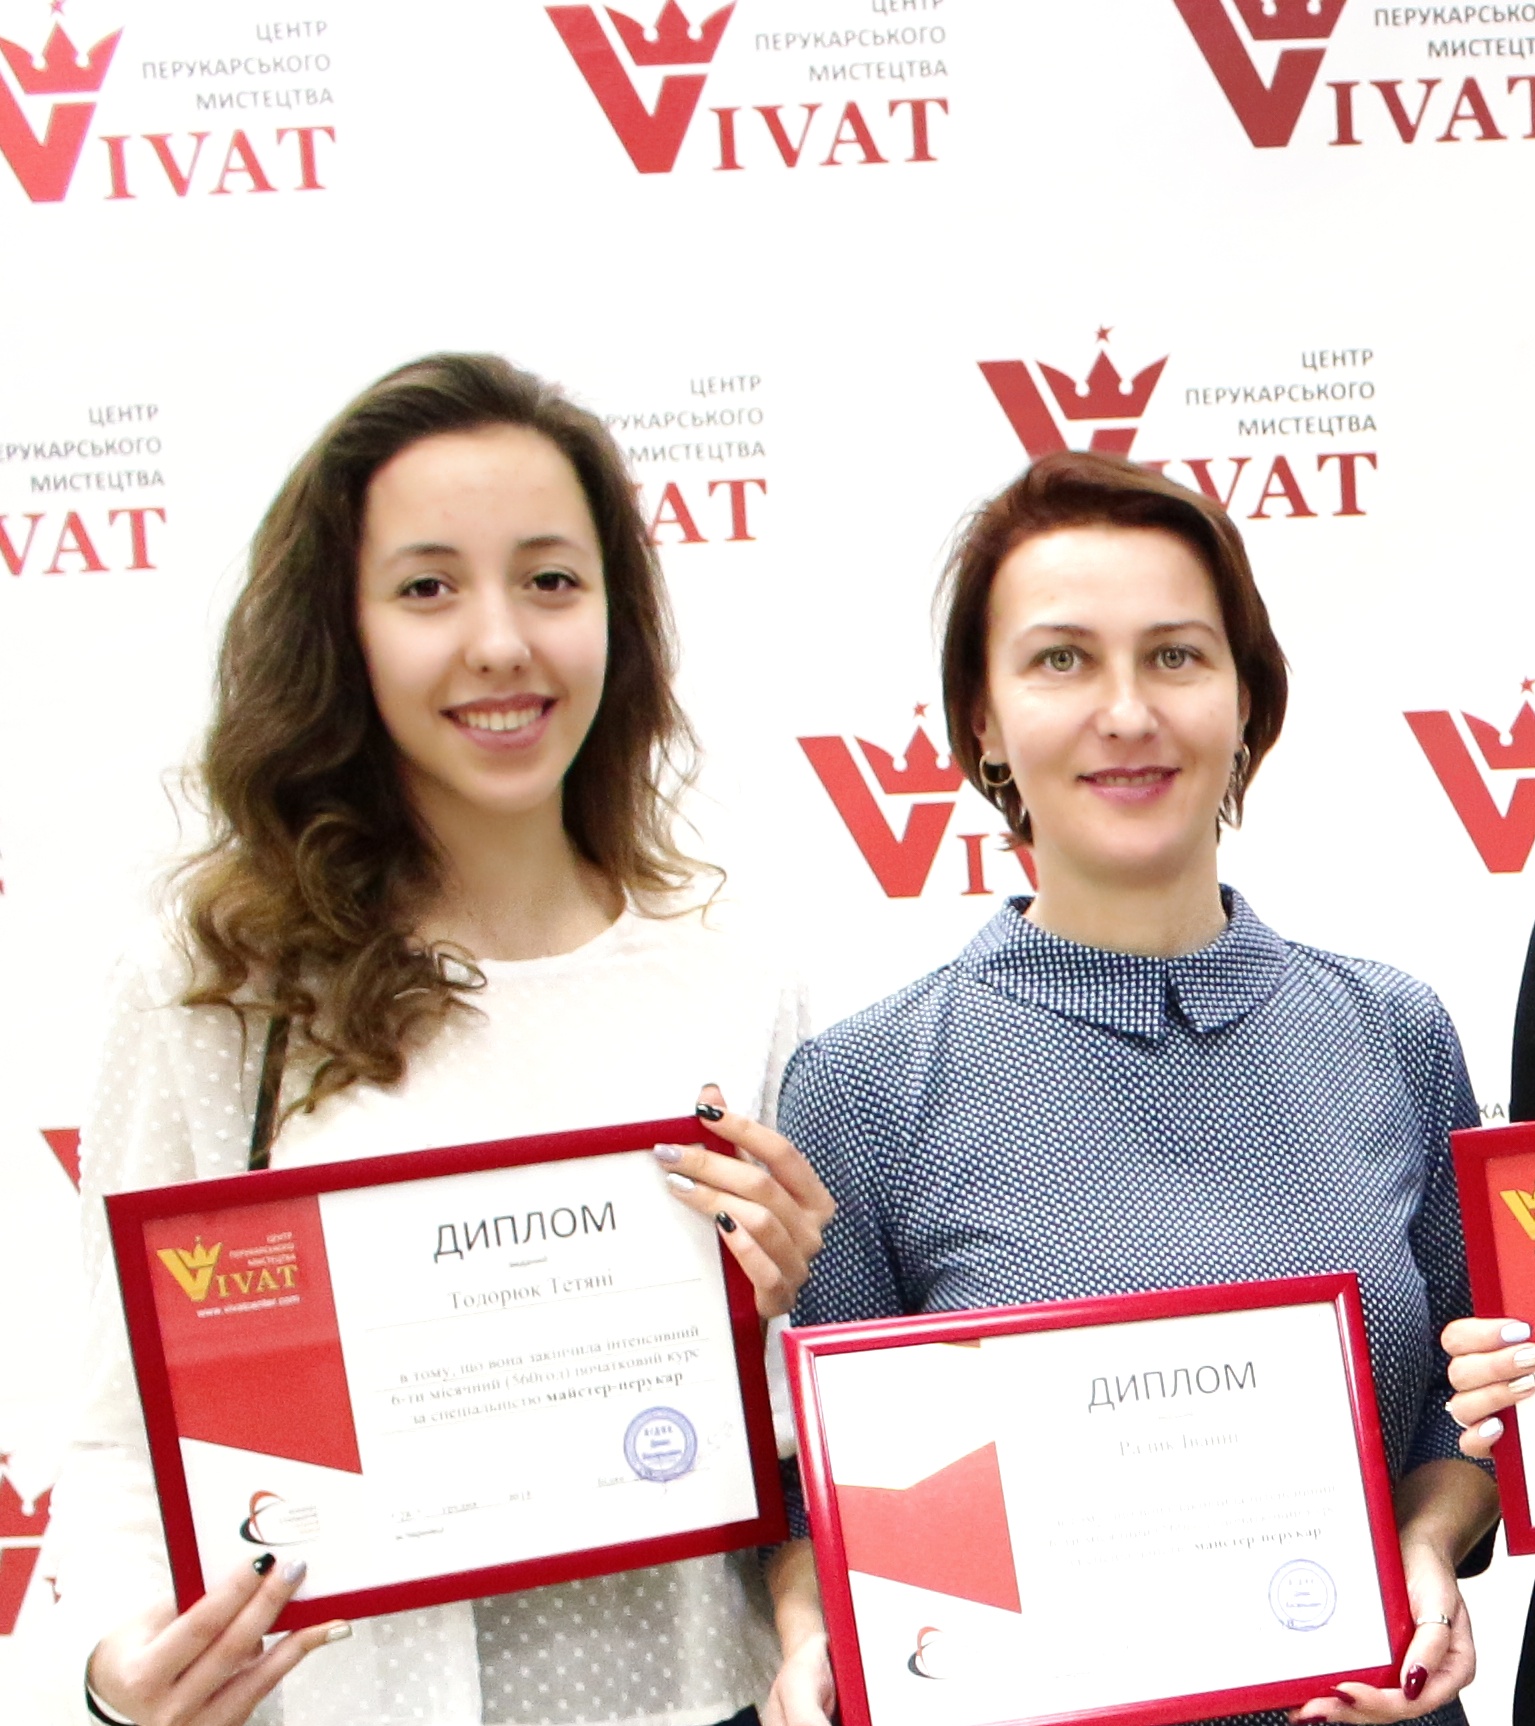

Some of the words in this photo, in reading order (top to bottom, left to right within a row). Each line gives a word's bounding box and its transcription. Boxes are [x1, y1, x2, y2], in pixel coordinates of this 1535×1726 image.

[255, 20, 328, 44] ЦЕНТР
[755, 25, 946, 51] ПЕРУКАРСЬКОГО
[141, 53, 331, 80] ПЕРУКАРСЬКОГО
[808, 59, 949, 83] МИСТЕЦТВА
[195, 87, 334, 111] МИСТЕЦТВА
[543, 0, 950, 174] VIVAT
[1301, 348, 1374, 372] ЦЕНТР
[690, 375, 762, 399] ЦЕНТР
[1185, 381, 1375, 406] ПЕРУКАРСЬКОГО
[88, 404, 159, 428] ЦЕНТР
[1238, 414, 1378, 437] МИСТЕЦТВА
[0, 436, 162, 461] РУКАРСЬКОГО
[30, 469, 166, 493] МИСТЕЦТВА
[0, 507, 167, 577] VAT
[433, 1201, 617, 1264] ДИПЛОМ
[157, 1240, 298, 1301] VIVAT
[1088, 1361, 1257, 1414] ДИПЛОМ
